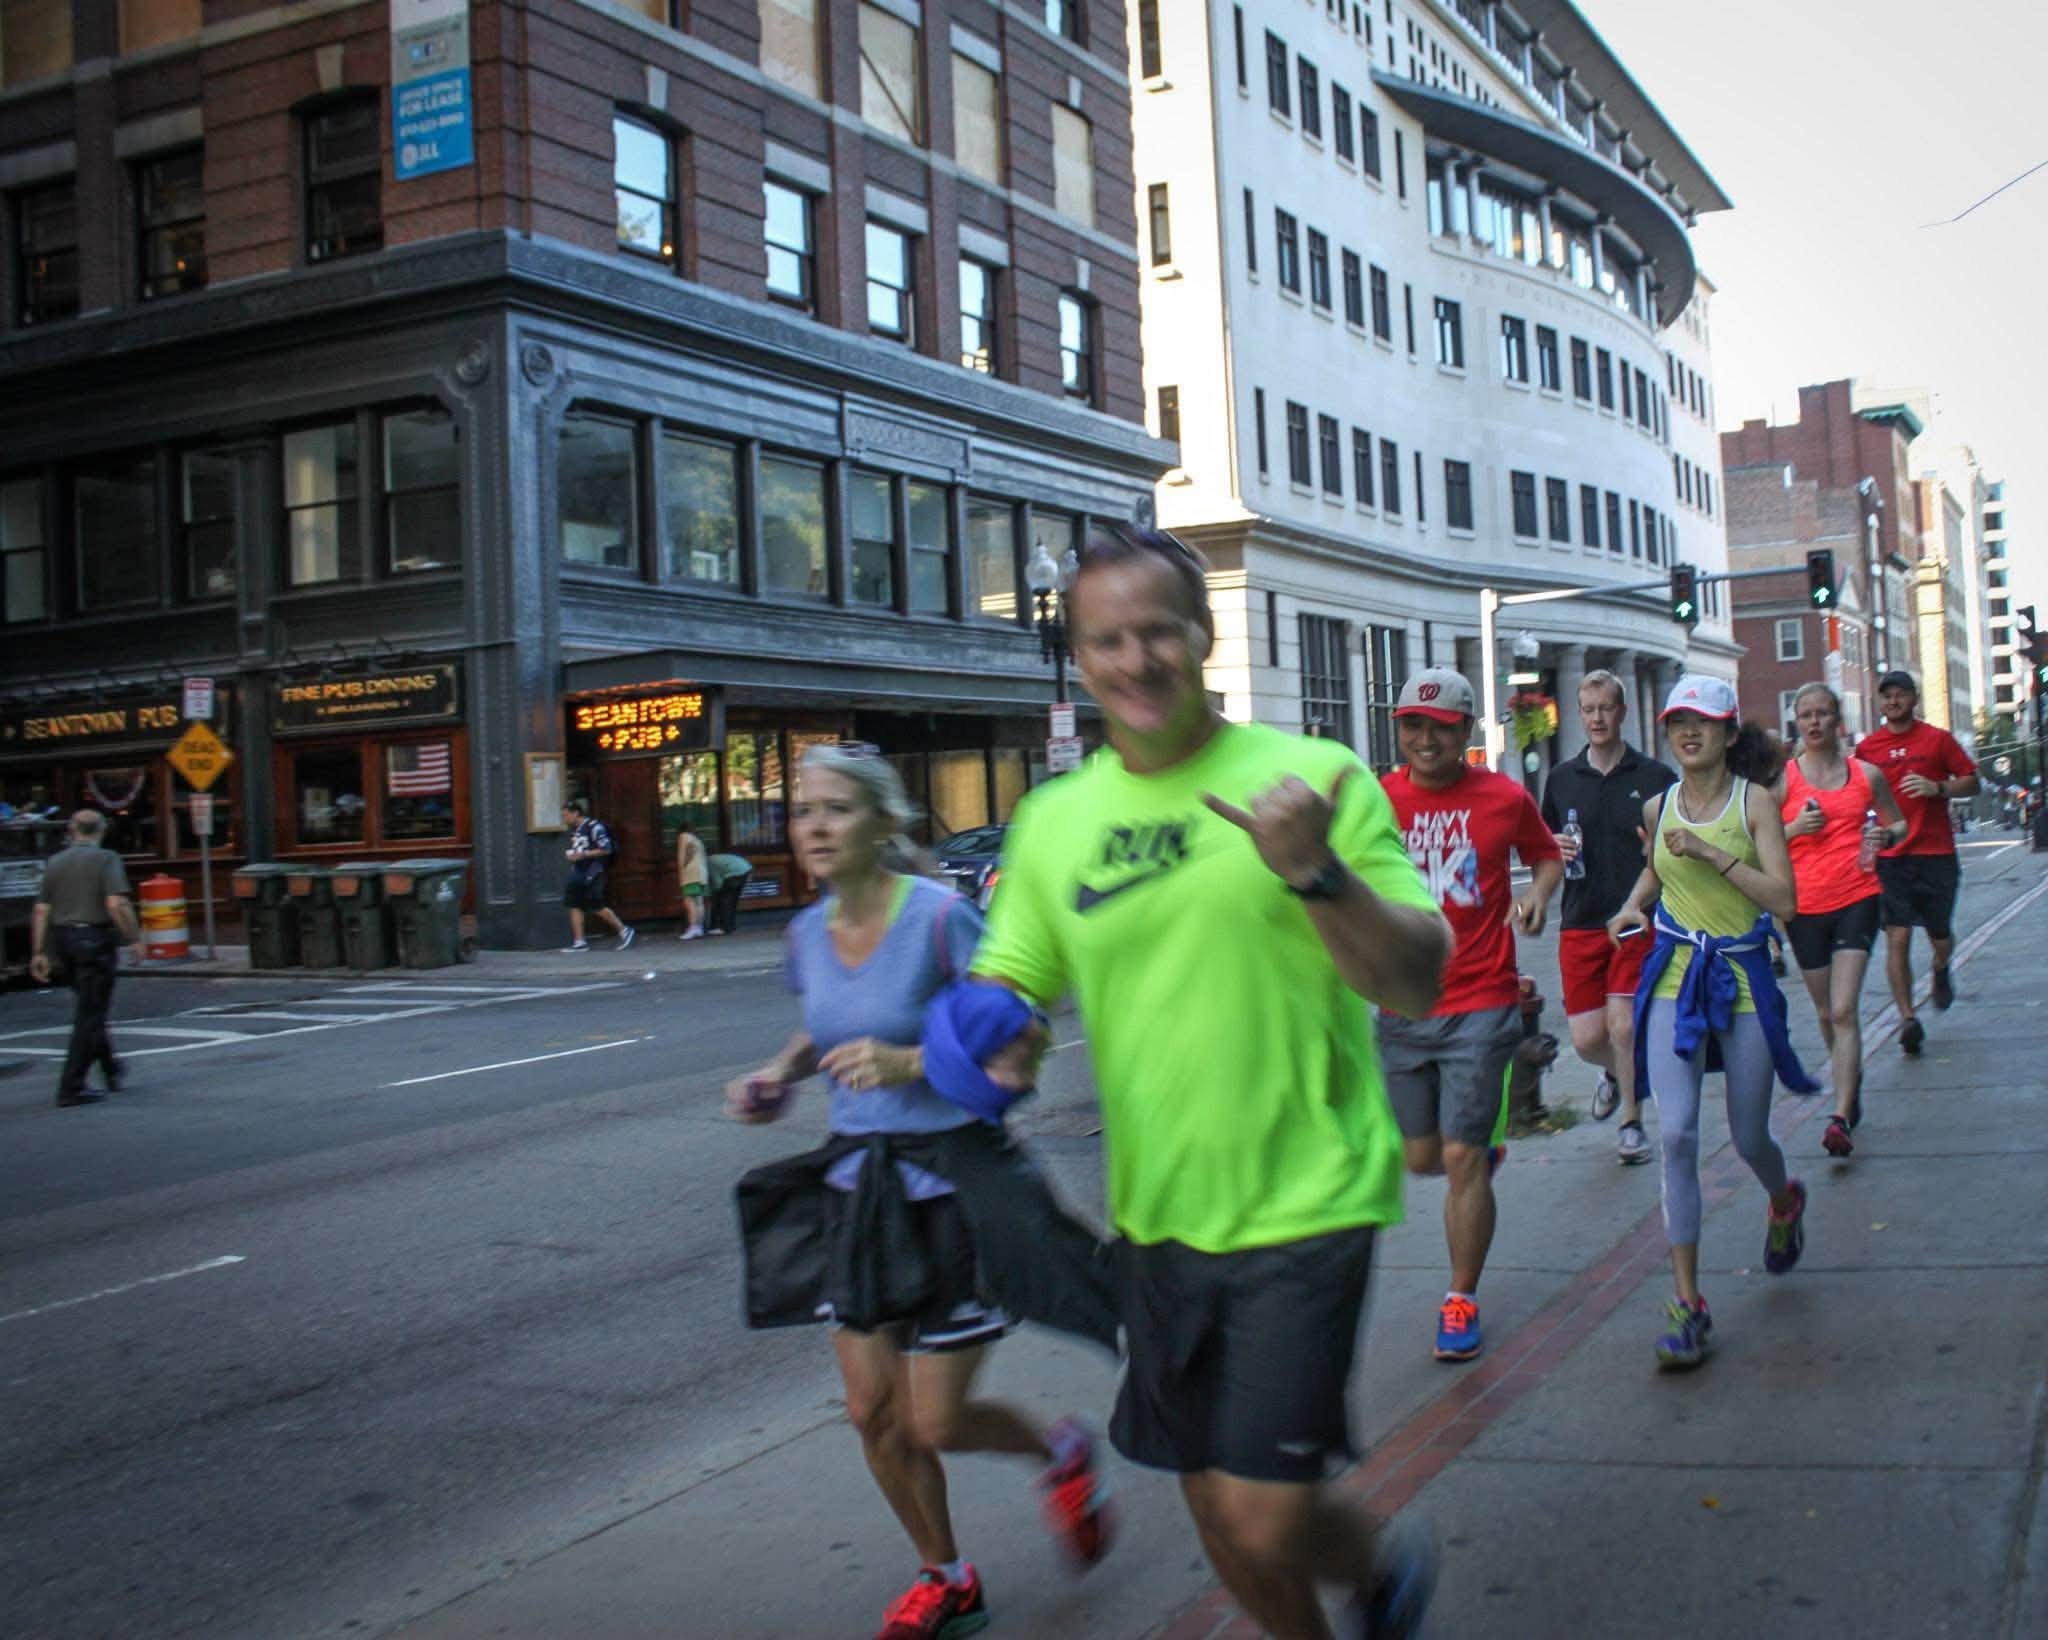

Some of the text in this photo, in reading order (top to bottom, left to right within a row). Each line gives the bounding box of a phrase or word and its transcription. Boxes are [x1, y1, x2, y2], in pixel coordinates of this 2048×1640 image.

[282, 674, 437, 703] FINE PUB DINING
[1419, 683, 1441, 702] W
[137, 705, 178, 729] PUB
[184, 741, 217, 753] DEAD
[187, 757, 214, 770] END
[1413, 808, 1471, 832] NAVY
